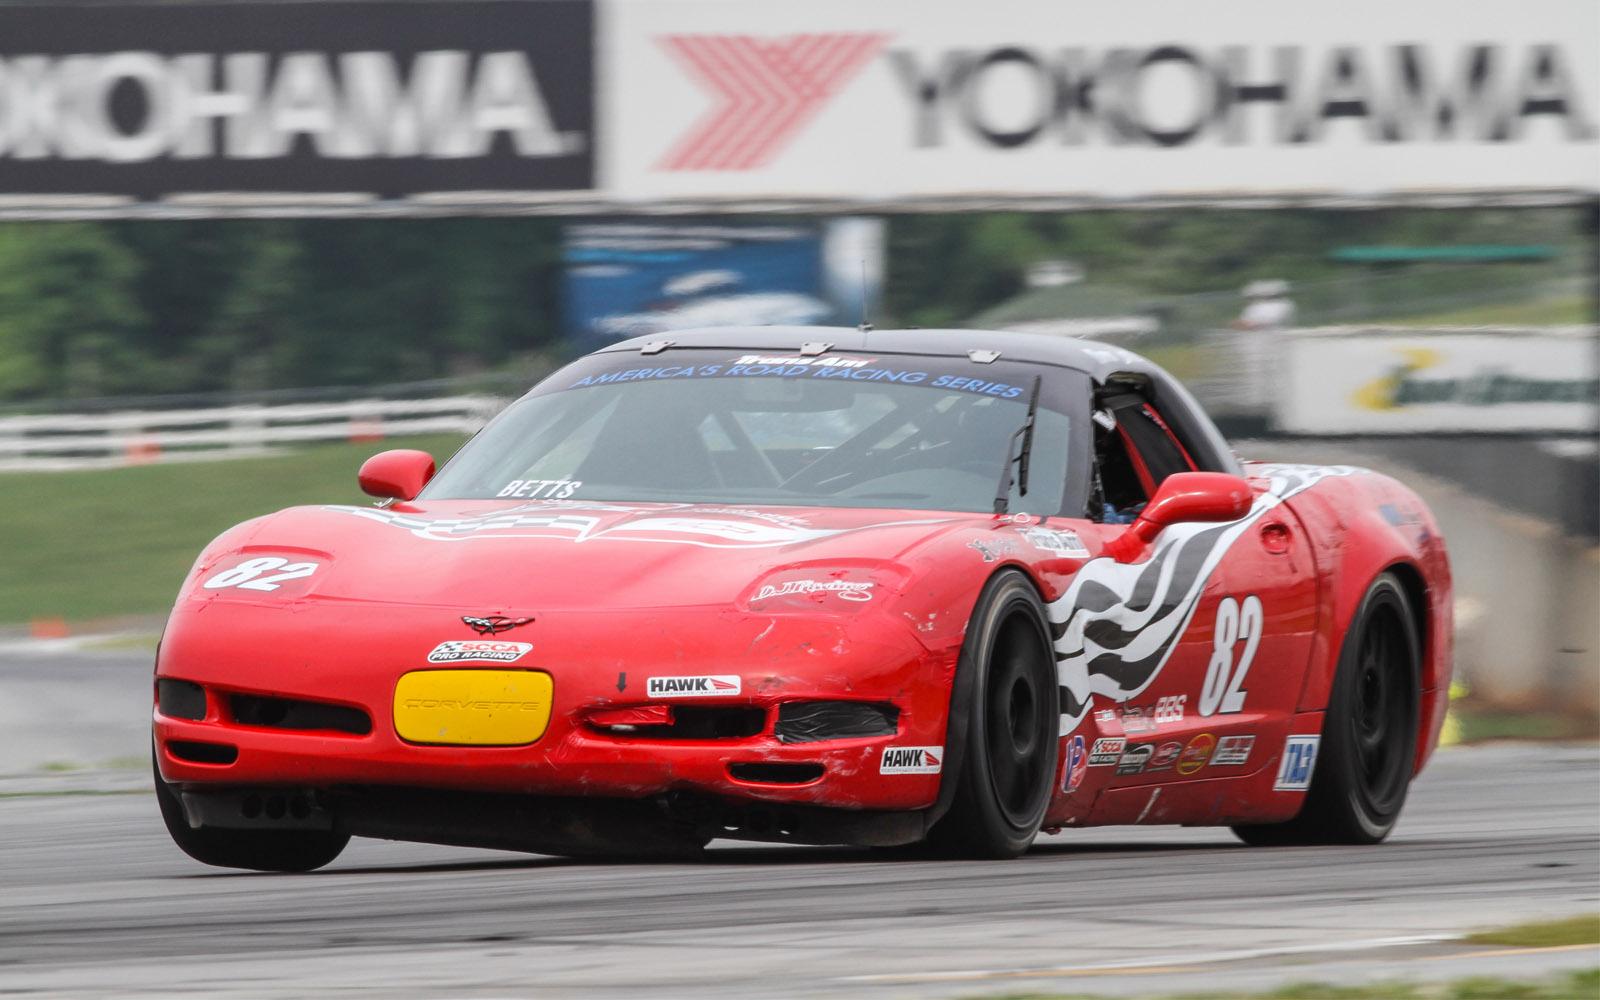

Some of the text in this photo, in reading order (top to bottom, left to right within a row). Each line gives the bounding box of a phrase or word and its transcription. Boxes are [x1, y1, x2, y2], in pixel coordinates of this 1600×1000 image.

[888, 43, 1597, 149] YOKOHAMA
[567, 364, 1025, 399] AMERICA'S ROAD RACING SERIES
[495, 479, 583, 499] BETTS
[203, 557, 320, 592] 82
[431, 651, 517, 660] PRO RACING
[461, 643, 520, 652] SCCA
[1197, 595, 1264, 717] 82
[650, 678, 708, 692] HAWK
[403, 698, 540, 712] CORVETTE
[1154, 694, 1188, 723] BBS
[883, 749, 924, 767] HAWK
